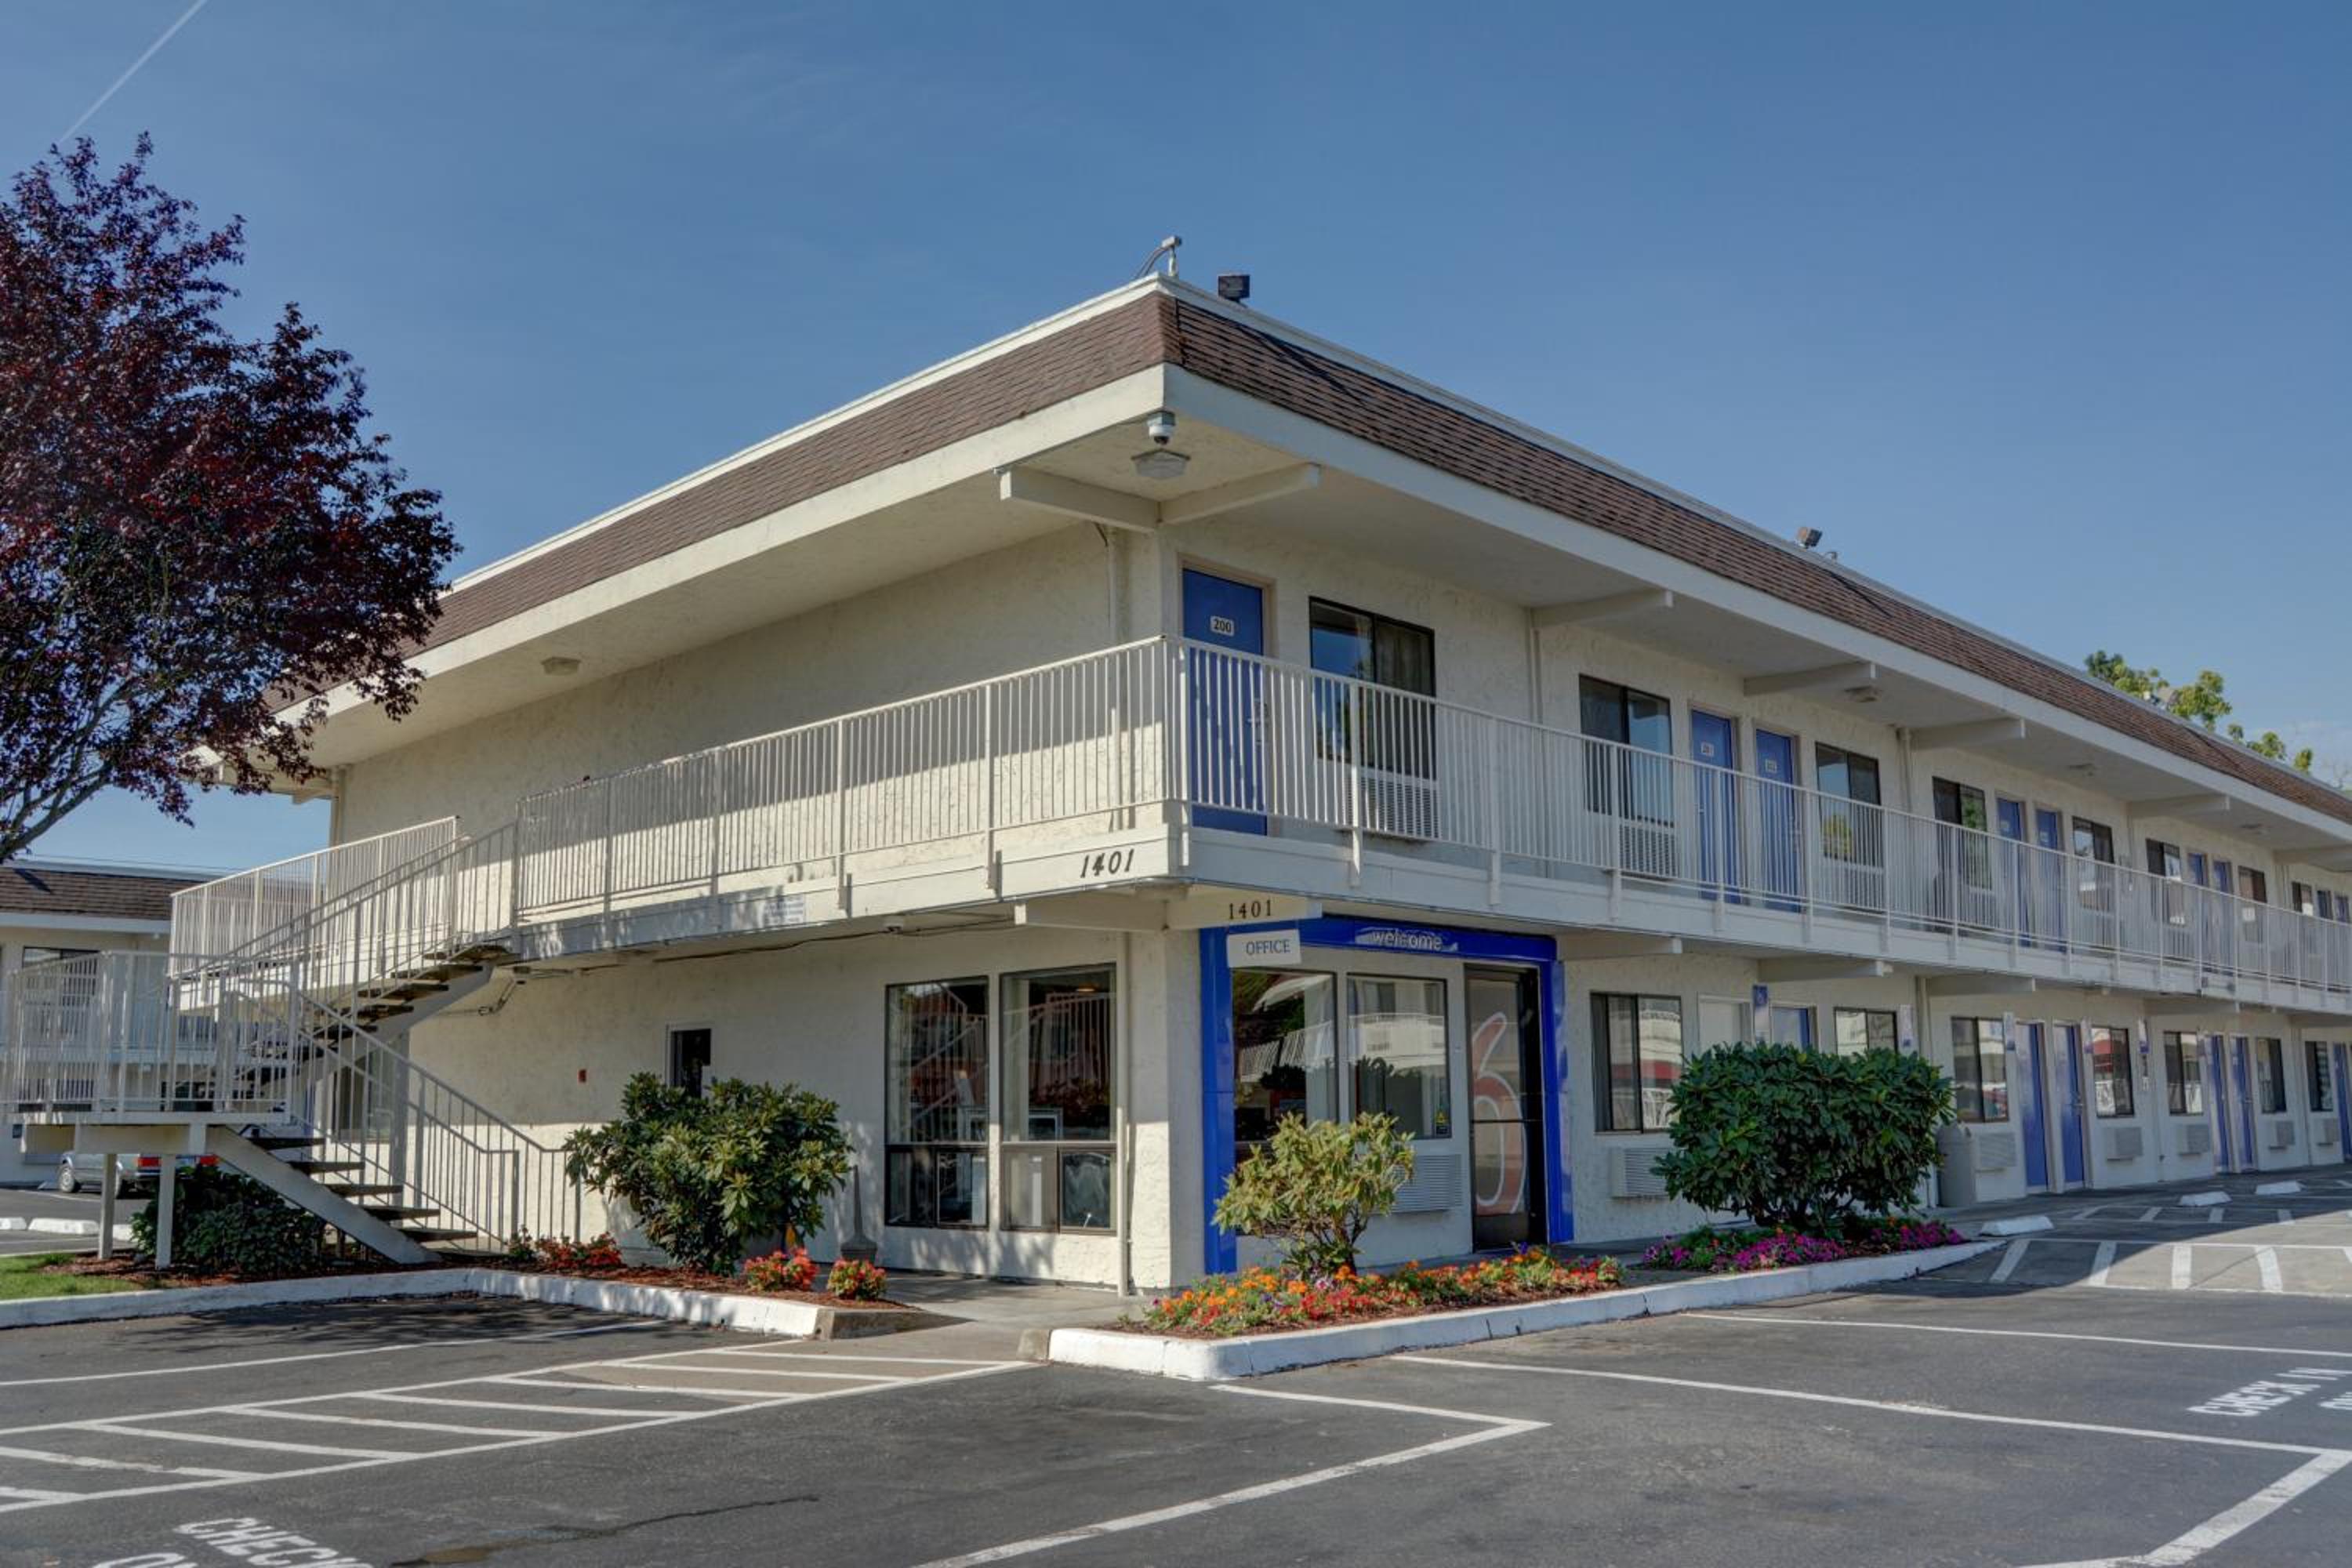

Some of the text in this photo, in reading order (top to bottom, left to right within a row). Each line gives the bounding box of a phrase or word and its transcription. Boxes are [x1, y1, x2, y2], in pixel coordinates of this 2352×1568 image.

[1214, 619, 1232, 633] 200
[1080, 848, 1134, 878] 1401
[1229, 899, 1272, 920] 1401
[1246, 938, 1291, 955] OFFICE
[1373, 928, 1443, 950] welcome
